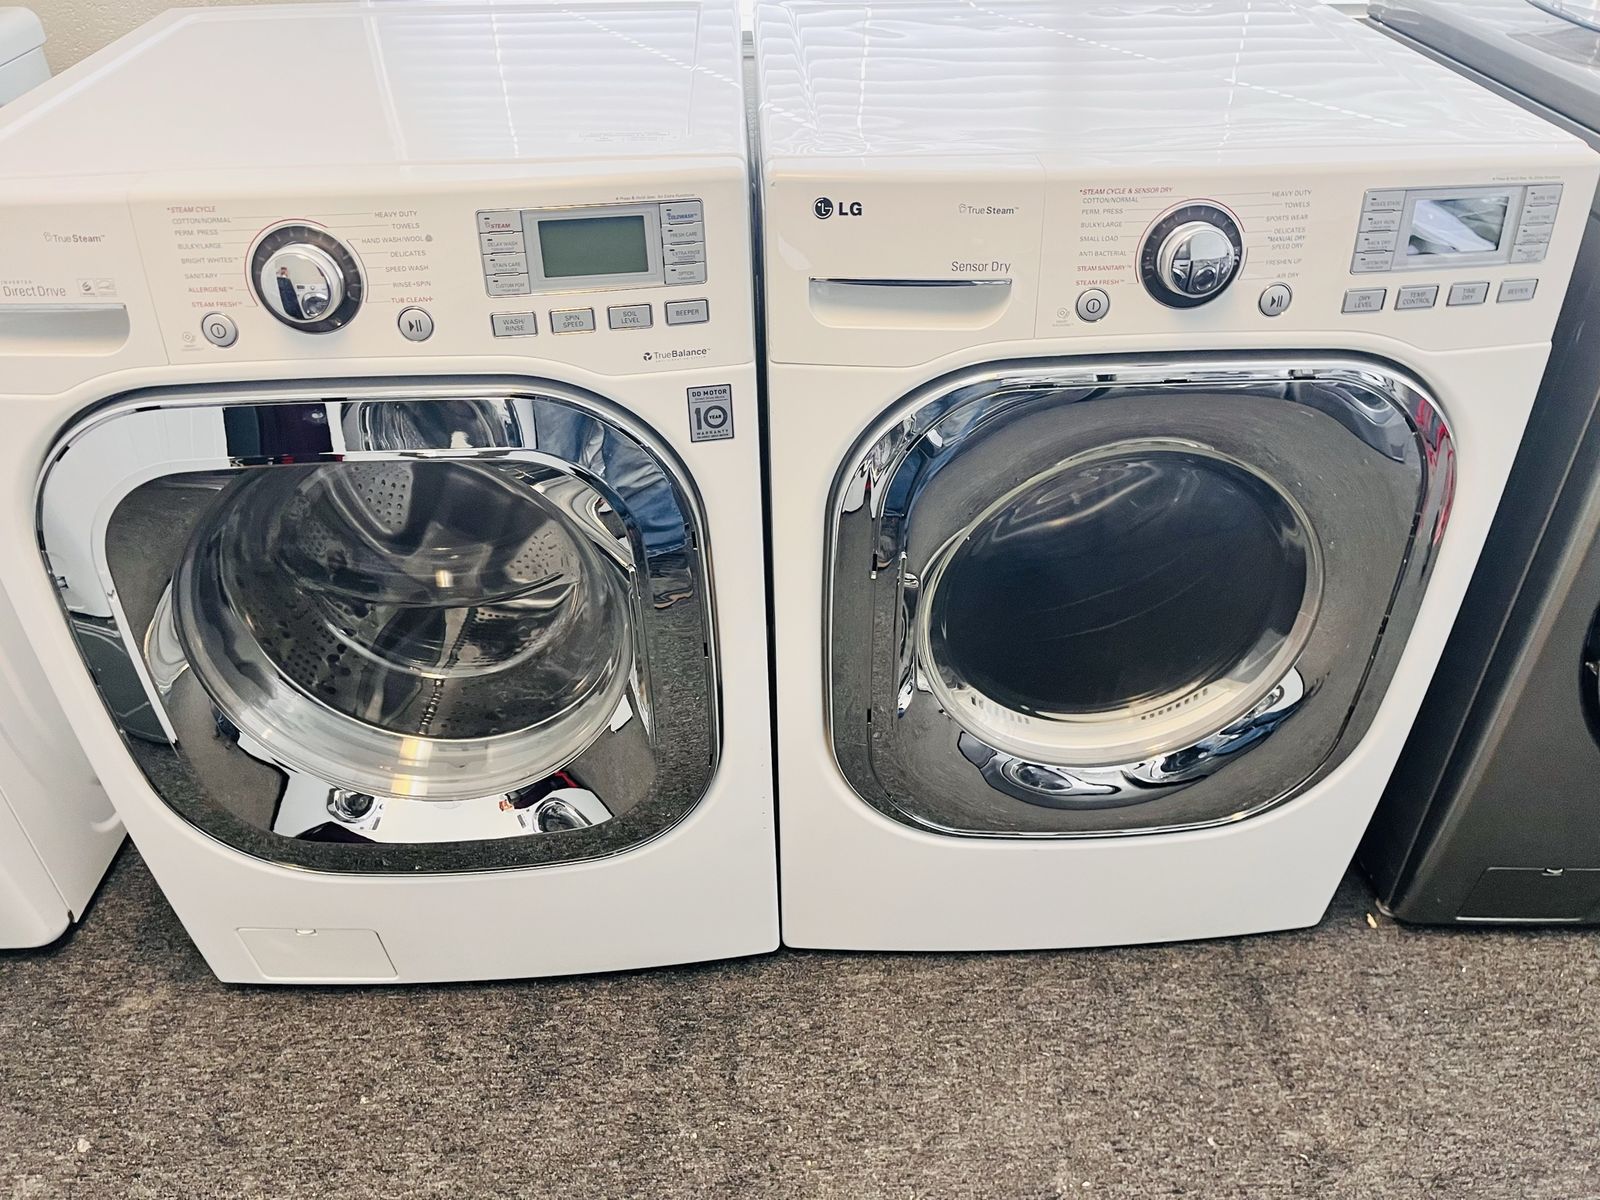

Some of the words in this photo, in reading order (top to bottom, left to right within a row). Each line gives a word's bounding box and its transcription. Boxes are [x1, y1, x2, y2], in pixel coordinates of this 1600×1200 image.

[838, 202, 863, 216] LG
[391, 222, 420, 230] TOWELS
[390, 250, 426, 258] DELICATES
[951, 261, 989, 272] Sensor
[990, 261, 1012, 276] Dry
[675, 309, 700, 317] BEEPER
[564, 314, 580, 322] SPIN
[621, 317, 641, 325] LEVEL
[505, 324, 525, 332] RINSE
[563, 320, 584, 328] SPEED
[694, 405, 728, 430] 10
